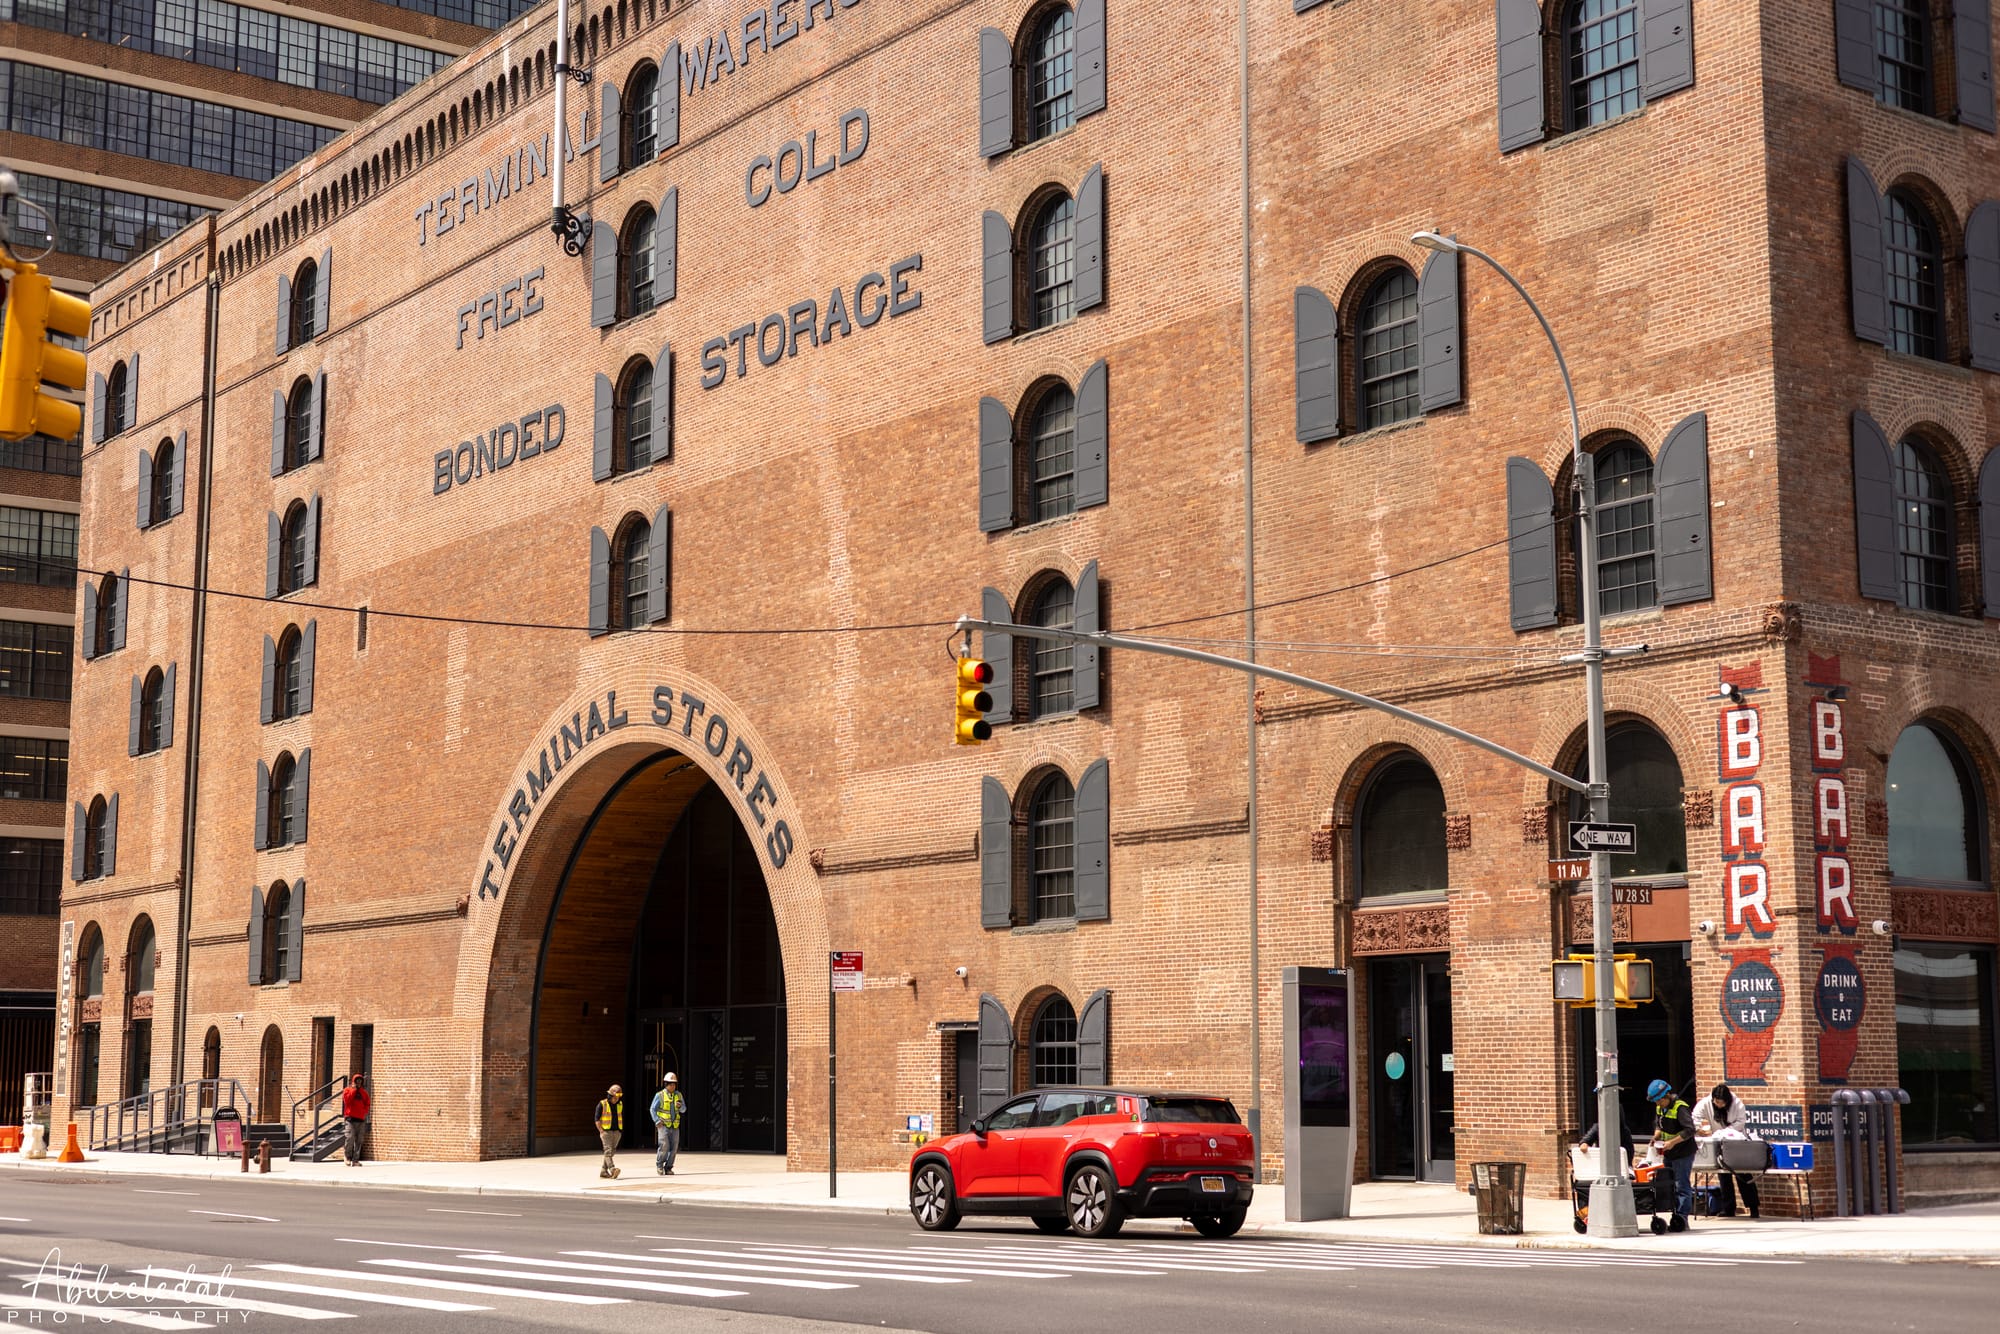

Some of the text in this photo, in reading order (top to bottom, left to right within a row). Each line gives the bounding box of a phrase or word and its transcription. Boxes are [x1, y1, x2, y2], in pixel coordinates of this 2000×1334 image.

[745, 107, 869, 208] COLD
[456, 265, 545, 350] FREE
[700, 252, 922, 390] STORAGE
[433, 403, 566, 496] BONDED
[478, 685, 793, 901] TERMINAL STORES
[1722, 706, 1774, 932] BAR
[1813, 699, 1856, 924] BAR
[1579, 831, 1627, 844] ONE WAY
[1557, 863, 1582, 878] 11 Av
[1615, 888, 1650, 903] W 28 St
[1731, 978, 1774, 993] DRINK
[1823, 974, 1858, 988] DRINK
[1750, 996, 1757, 1005] &
[1741, 1009, 1767, 1024] EAT
[1831, 1008, 1852, 1022] EAT
[1745, 1110, 1798, 1125] CHLIGHT
[1760, 1128, 1779, 1136] GOOD
[1781, 1129, 1799, 1137] TIME
